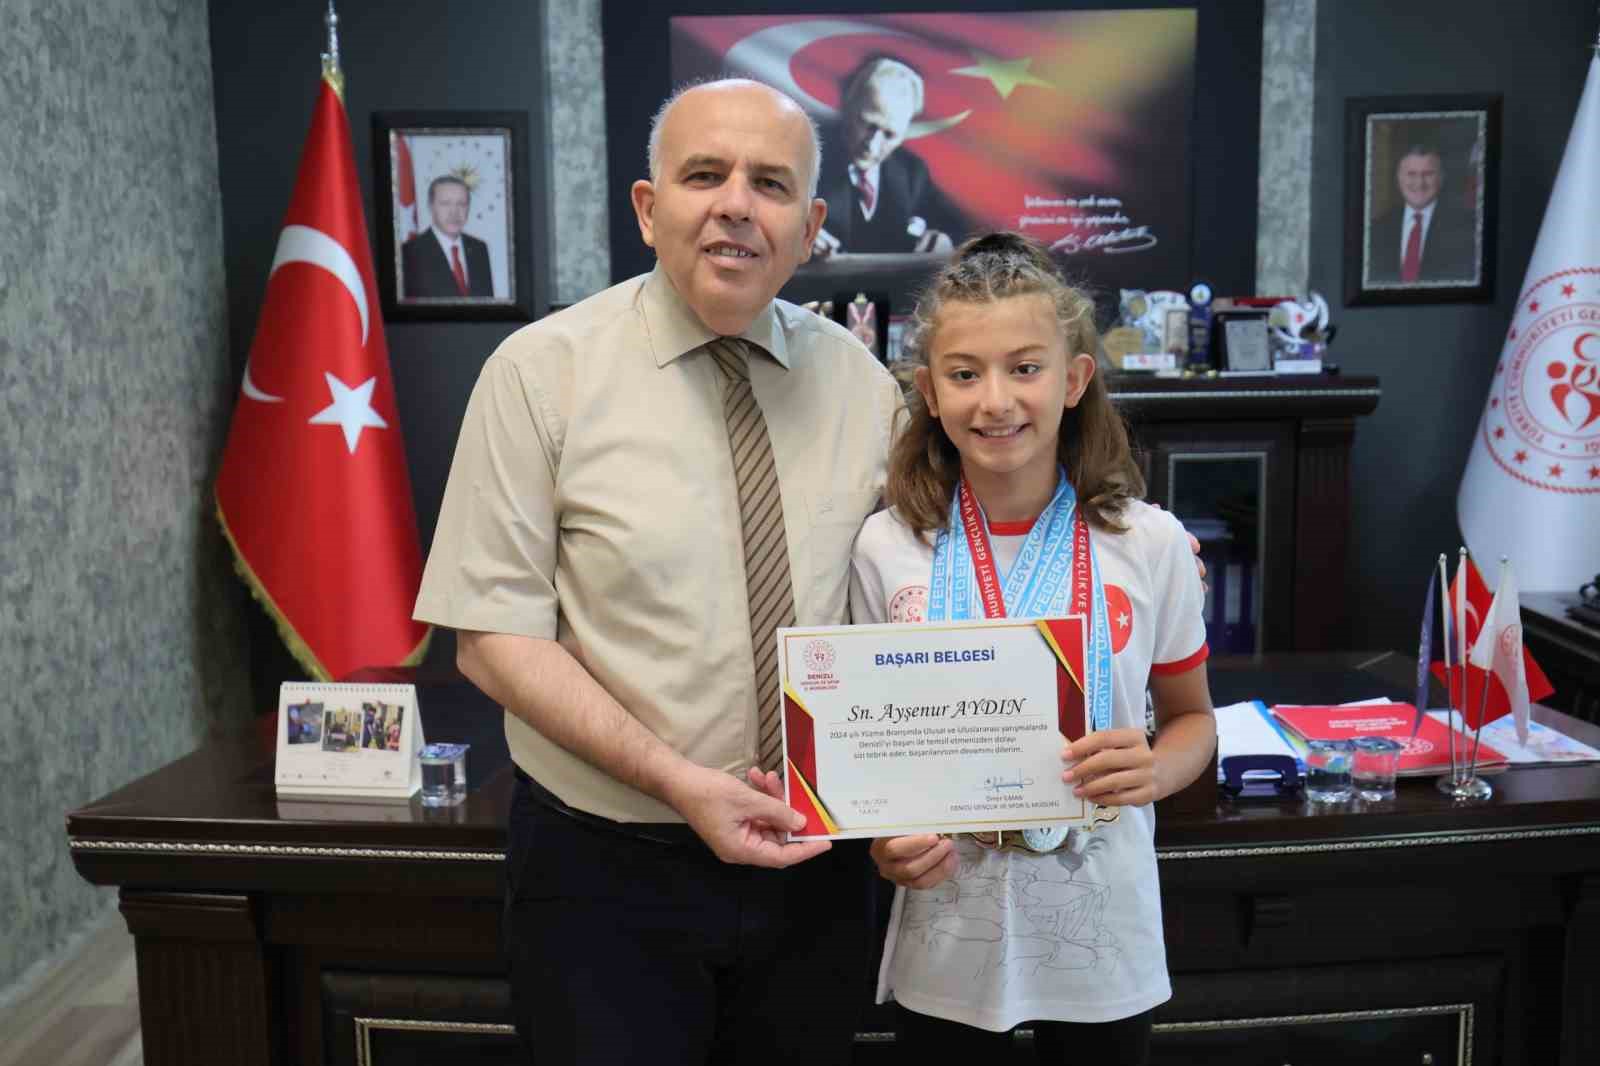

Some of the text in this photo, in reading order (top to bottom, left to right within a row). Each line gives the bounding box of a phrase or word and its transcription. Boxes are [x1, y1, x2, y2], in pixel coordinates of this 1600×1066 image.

[967, 517, 986, 560] GENÇLİK
[930, 533, 948, 609] FEDERAS
[980, 564, 1000, 617] HURİYETİ
[1078, 591, 1087, 609] VE
[875, 647, 995, 668] BAŞARI BELGESİ
[847, 697, 1026, 724] Sn. Ayşenur AYDIN
